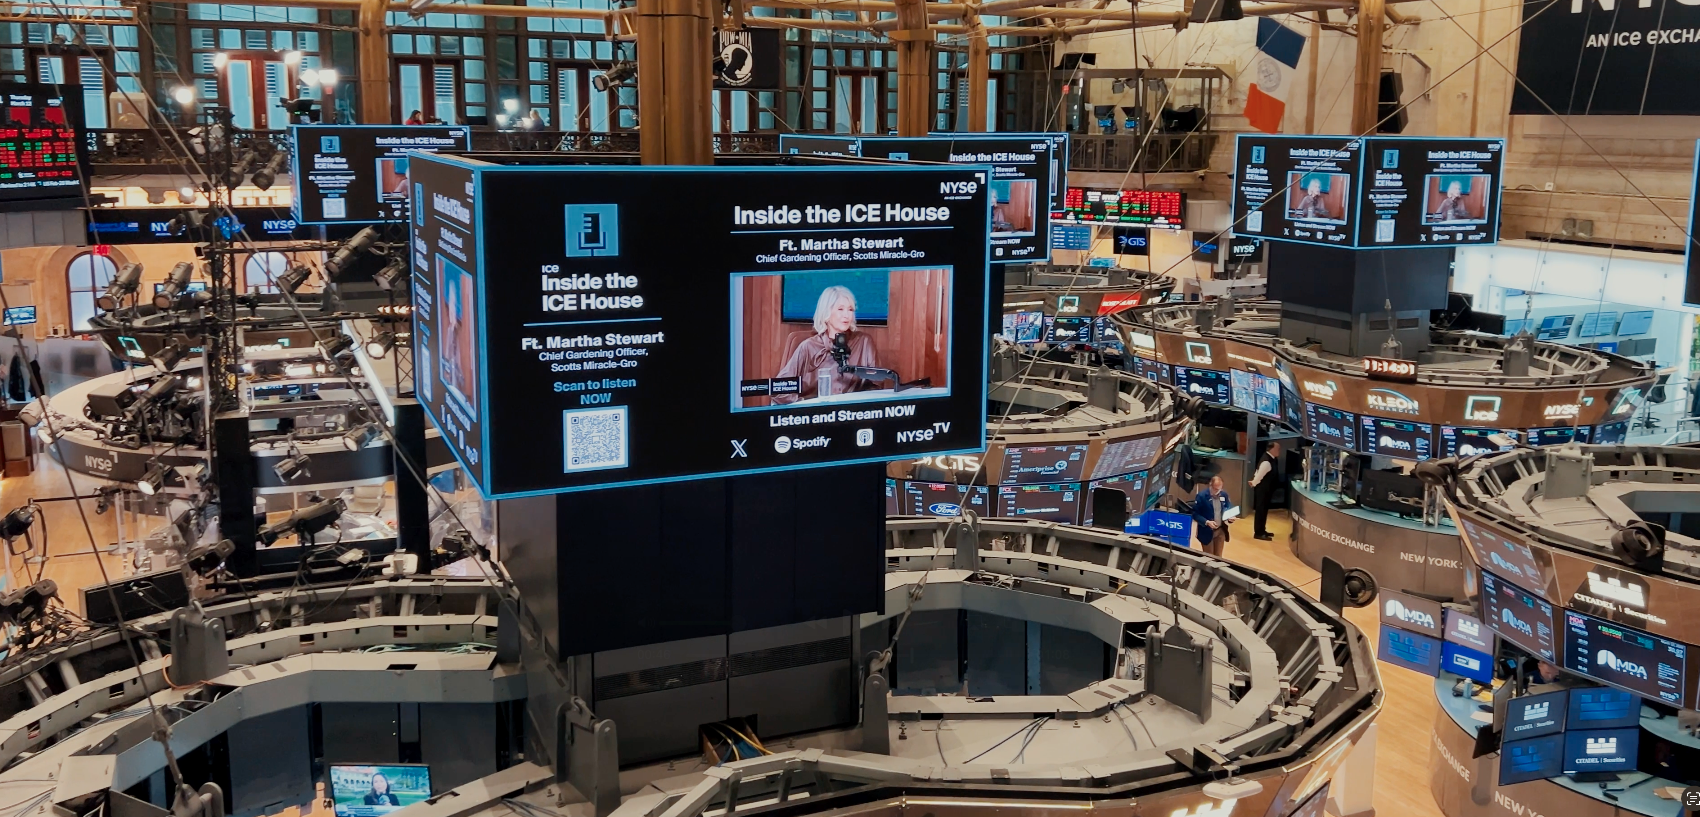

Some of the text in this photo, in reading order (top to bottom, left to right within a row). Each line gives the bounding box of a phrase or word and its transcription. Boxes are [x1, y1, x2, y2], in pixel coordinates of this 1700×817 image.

[1586, 34, 1608, 47] AN
[950, 153, 976, 162] Inside
[977, 153, 991, 161] the
[734, 204, 950, 225] Inside the ICE House
[780, 237, 904, 251] Ft. Martha Stewart
[1128, 238, 1146, 246] GTS
[756, 250, 925, 263] Chief Gardening Officer, Scotts Miracle-Gro
[542, 272, 638, 291] Inside the
[542, 293, 643, 311] ICE House
[522, 331, 664, 350] Ft. Martha Stewart
[539, 347, 648, 361] Chief Gardening Officer,
[551, 360, 637, 372] Scotts Miracle-Gro
[554, 378, 636, 392] Scan to listen
[580, 393, 611, 405] NOW
[1367, 394, 1419, 410] KLEON
[770, 405, 915, 427] Listen and Stream NOW
[793, 437, 830, 450] Spotify
[936, 455, 980, 471] GTS
[1310, 525, 1330, 540] STOCK
[1331, 534, 1375, 554] EXCHANGE
[1400, 552, 1425, 564] NEW
[1428, 556, 1458, 569] YORK
[1405, 608, 1434, 624] MDA
[1574, 593, 1666, 625] CITADEL Securities
[1617, 659, 1648, 676] MDA
[1495, 791, 1524, 816] NEW
